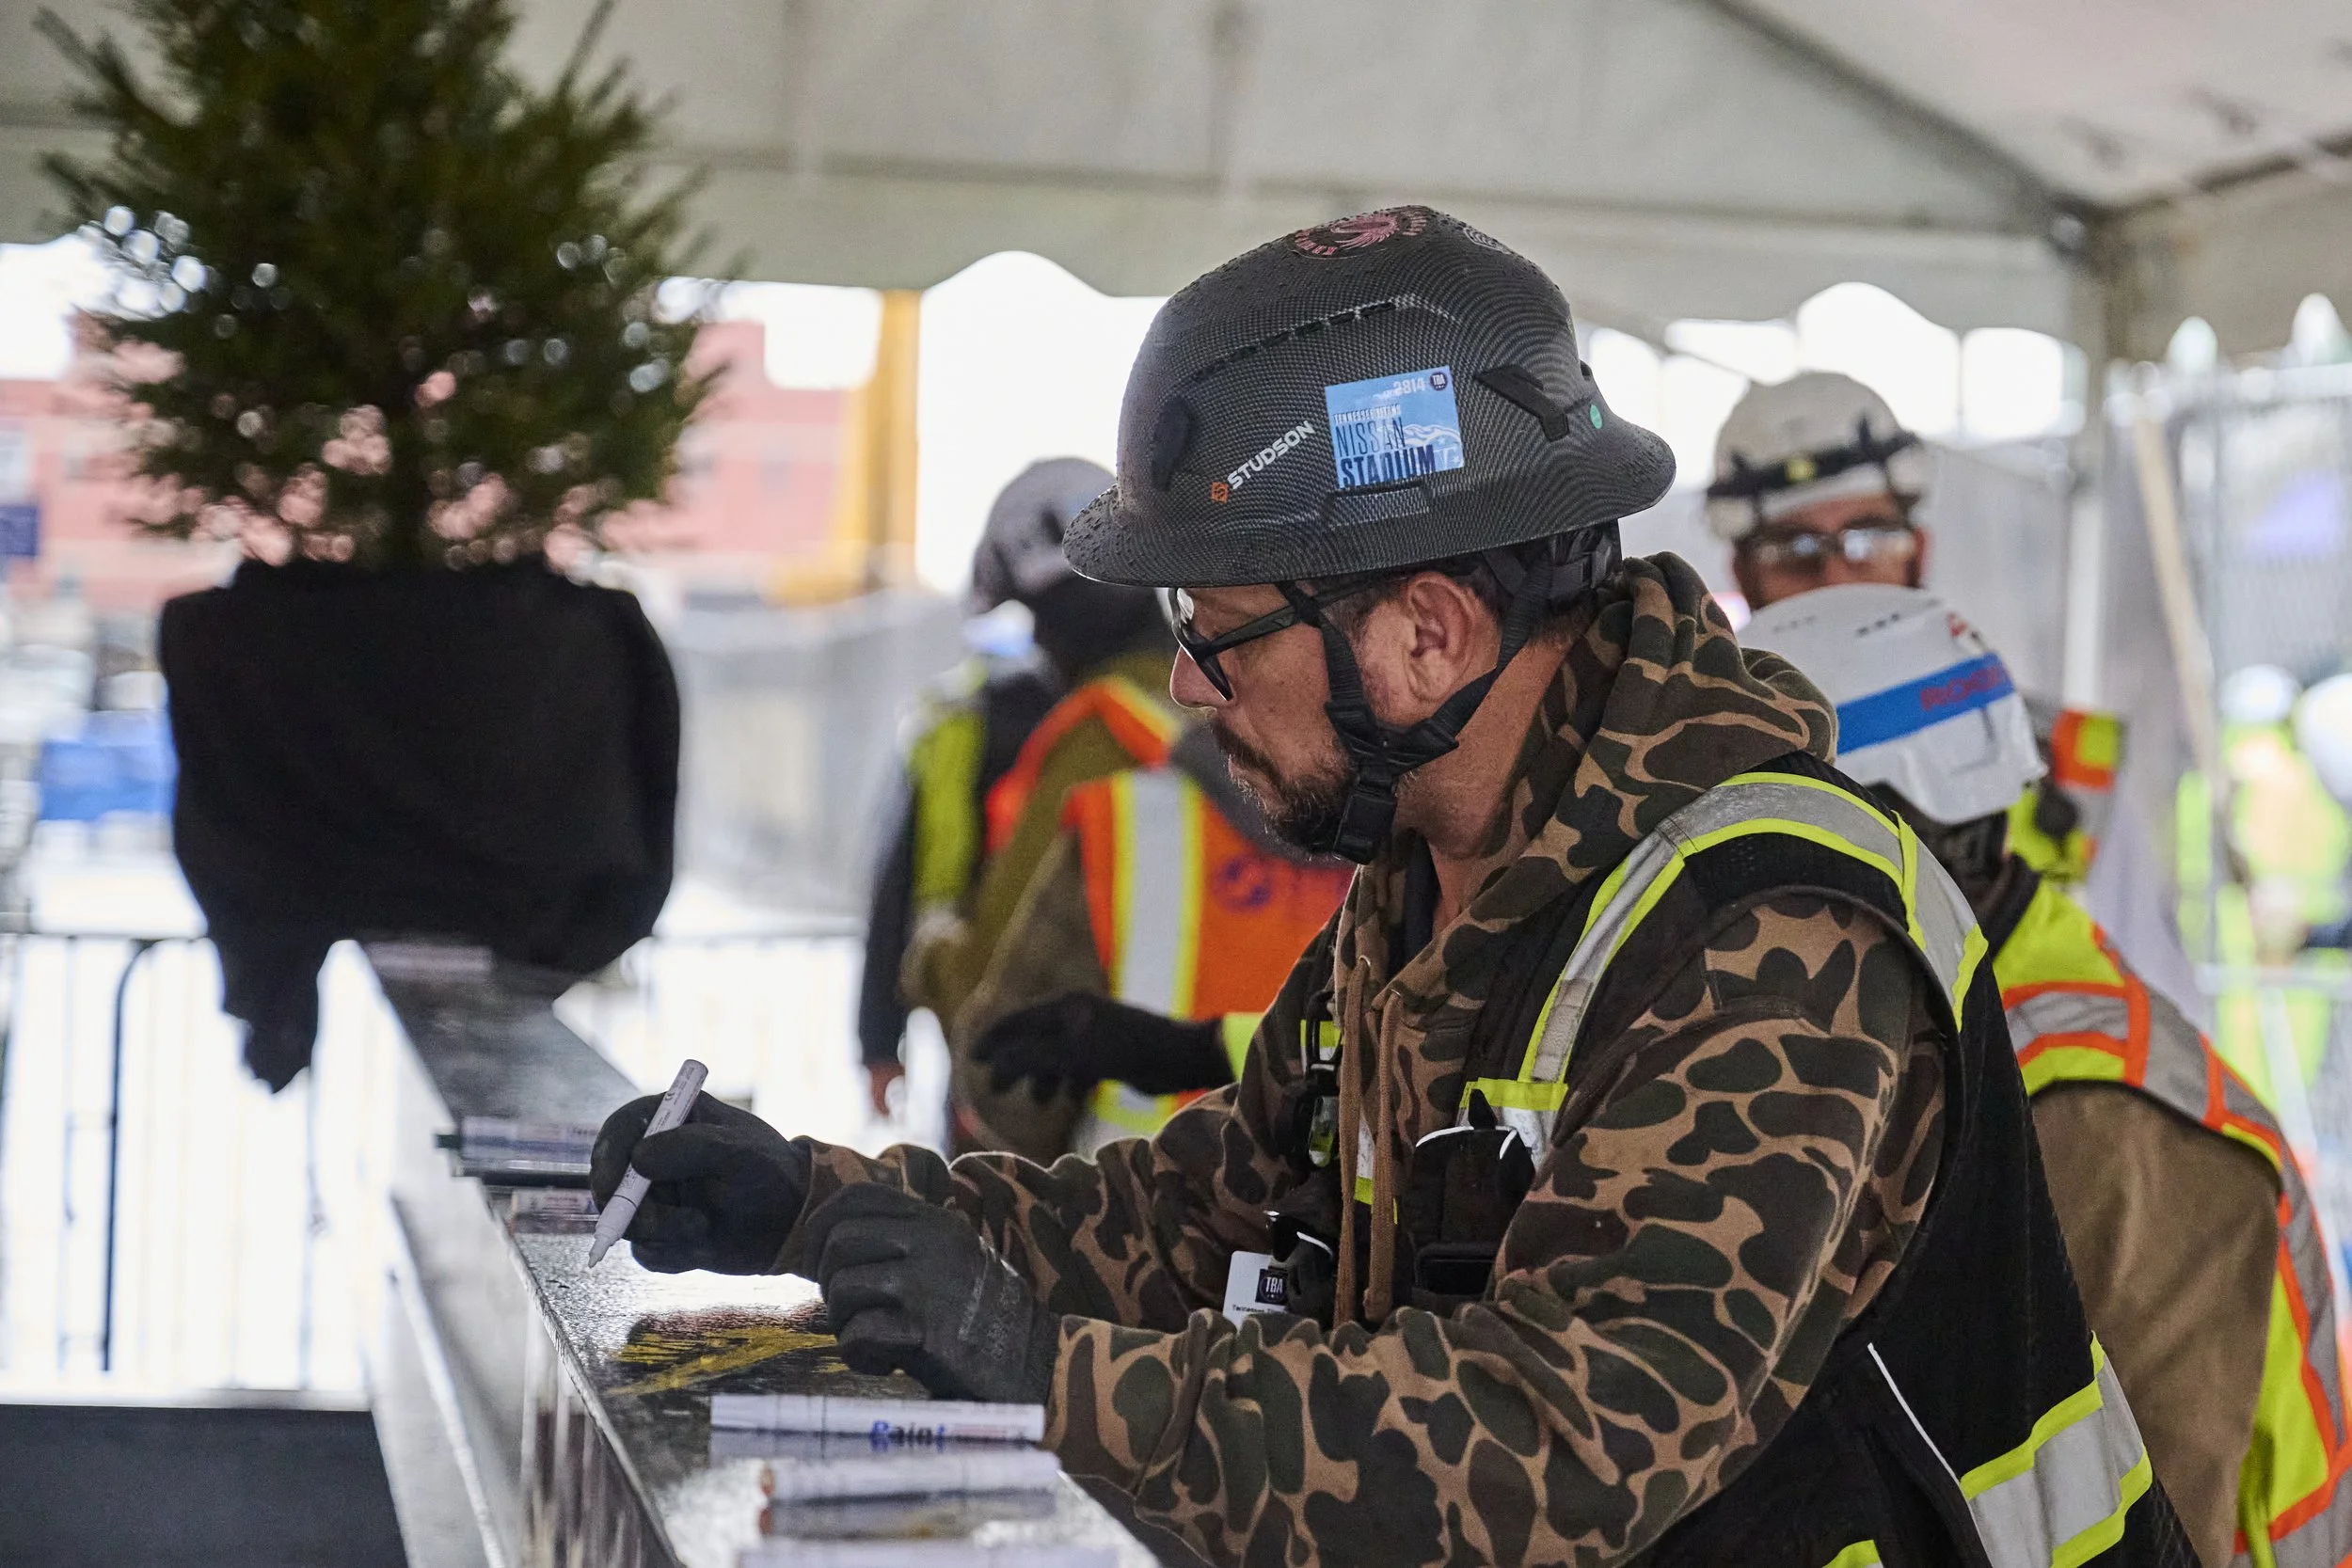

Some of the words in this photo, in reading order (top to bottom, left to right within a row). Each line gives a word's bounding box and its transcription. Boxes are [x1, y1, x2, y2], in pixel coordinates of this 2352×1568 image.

[1227, 420, 1316, 489] STUDSON
[1335, 417, 1406, 458] NISSAN
[1340, 444, 1437, 488] STADIUM
[1265, 1276, 1283, 1294] TBA
